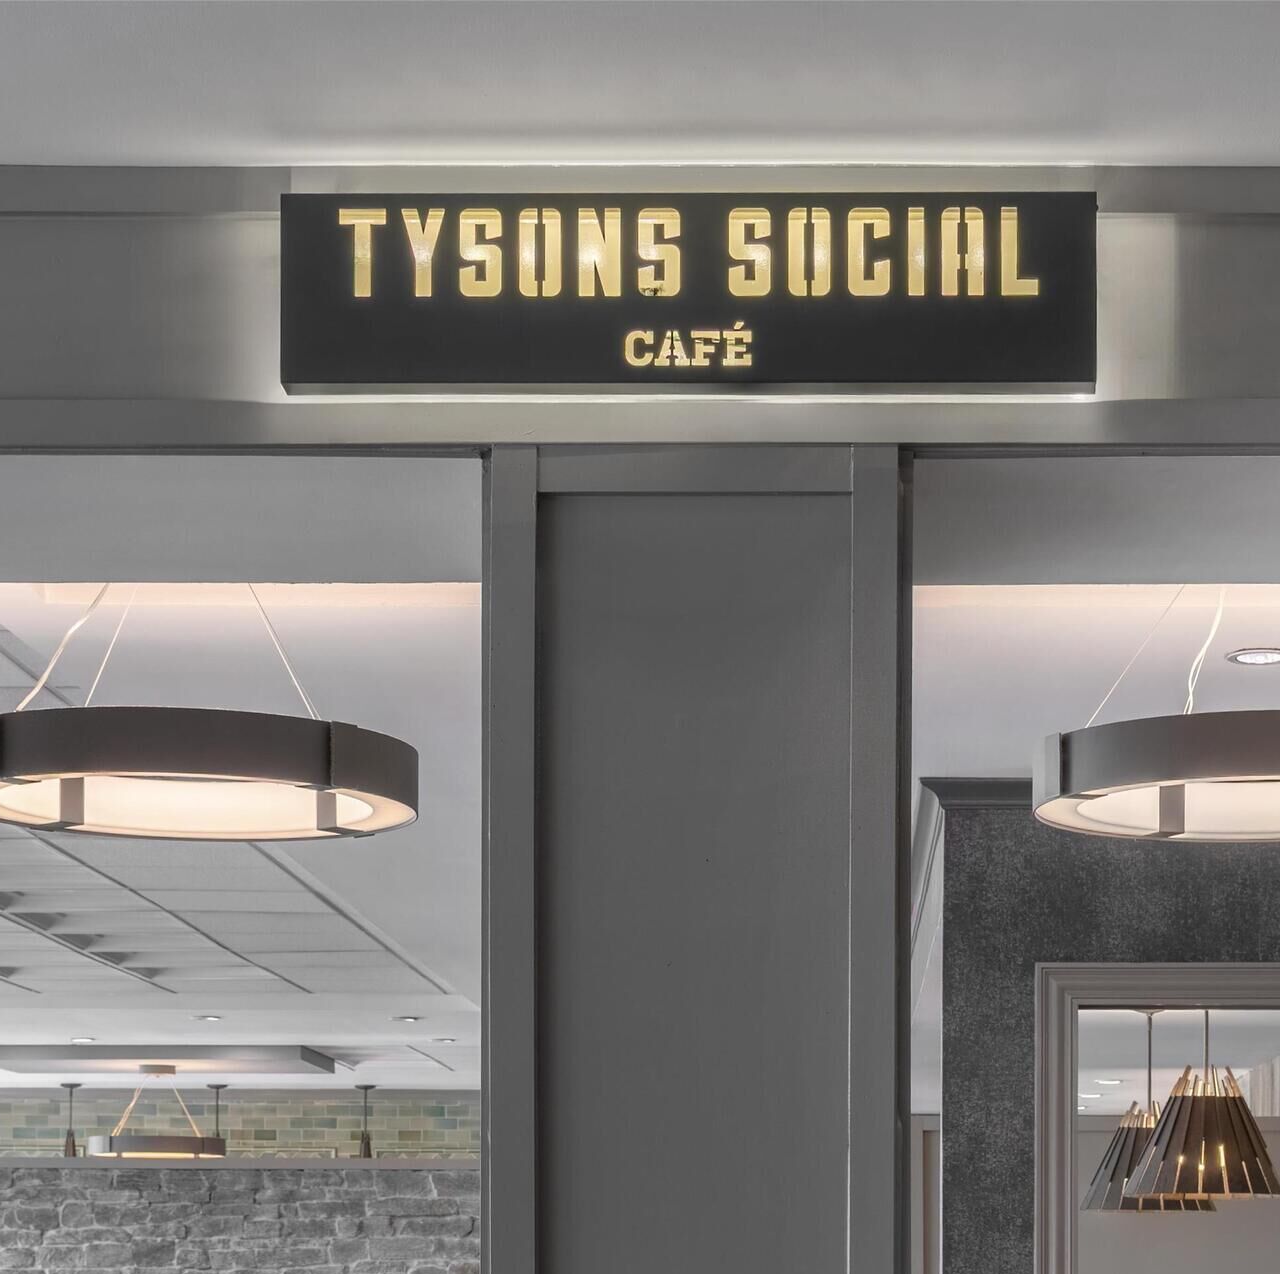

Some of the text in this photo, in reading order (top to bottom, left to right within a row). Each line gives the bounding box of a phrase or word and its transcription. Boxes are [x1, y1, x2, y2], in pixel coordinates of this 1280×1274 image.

[339, 206, 1039, 298] TYSONS SOCIAL
[624, 320, 753, 367] CAFÉ
